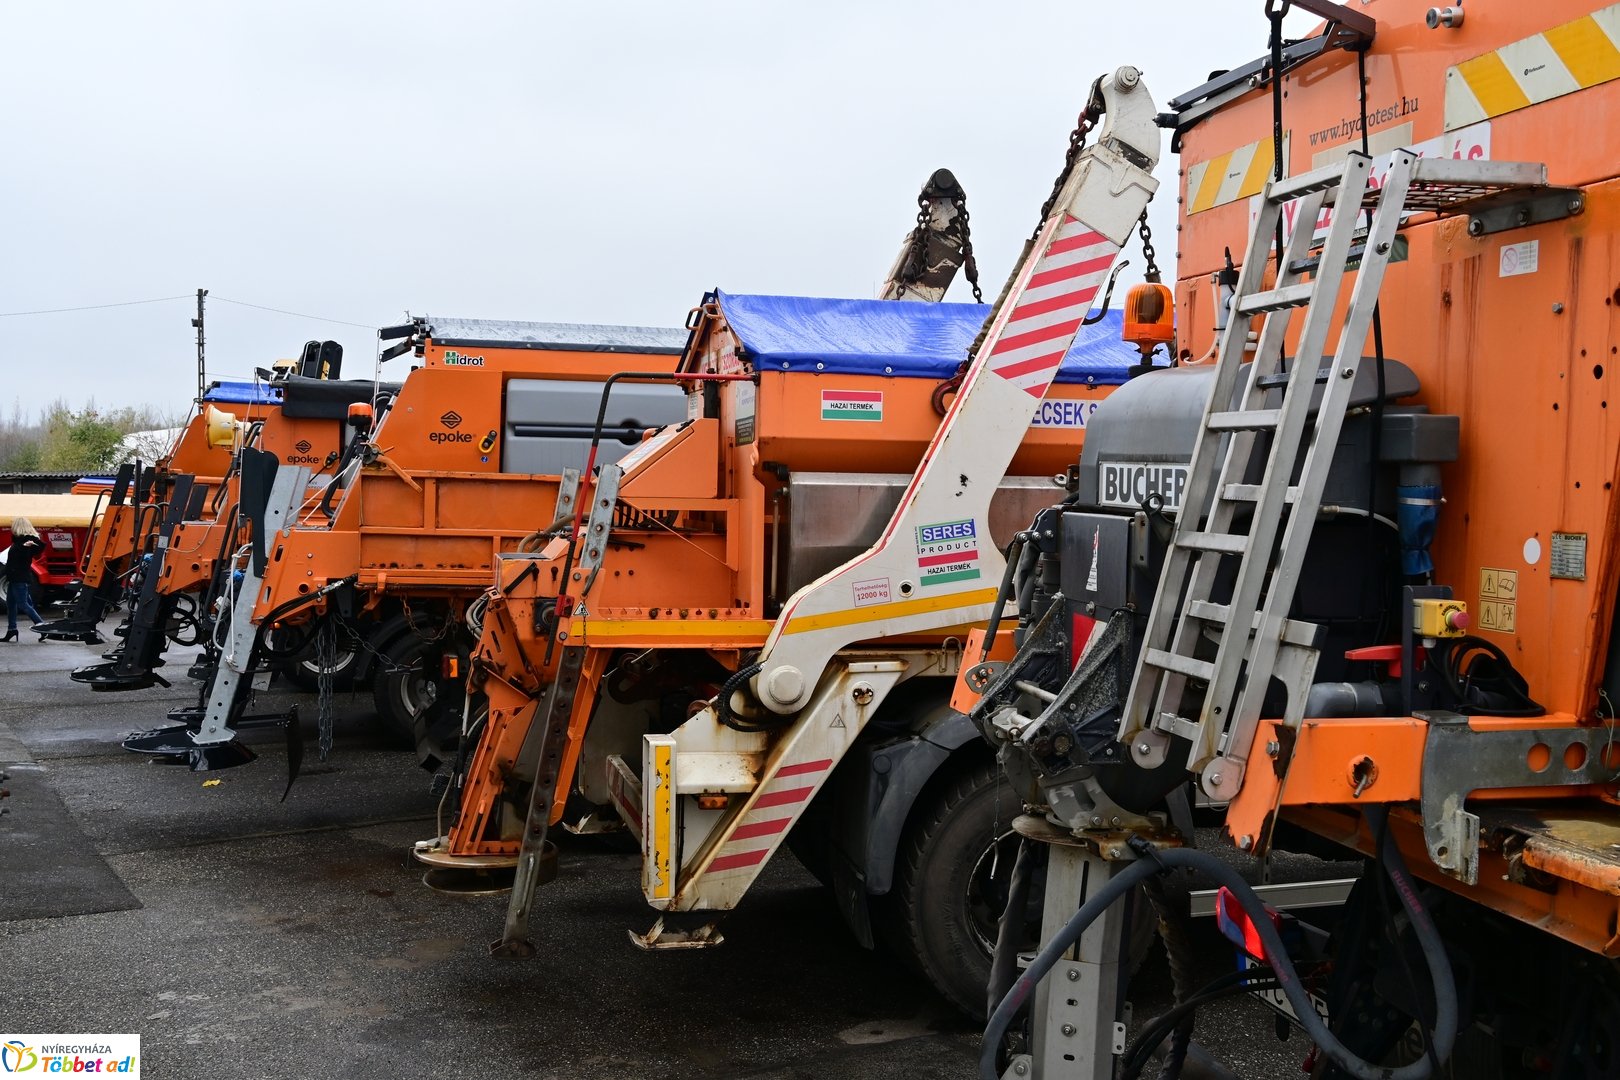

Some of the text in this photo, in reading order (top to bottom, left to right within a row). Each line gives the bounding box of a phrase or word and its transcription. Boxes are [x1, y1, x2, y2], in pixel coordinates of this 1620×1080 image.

[444, 351, 484, 366] Hidrot
[830, 402, 849, 410] HAZAI
[429, 431, 473, 444] epoke
[287, 455, 319, 464] epoke
[1105, 466, 1188, 507] BUCHER
[922, 523, 973, 542] SERES
[920, 540, 977, 555] PRODUCT
[927, 562, 972, 575] HAZAI TERMÉK
[857, 590, 888, 601] 12000 kg
